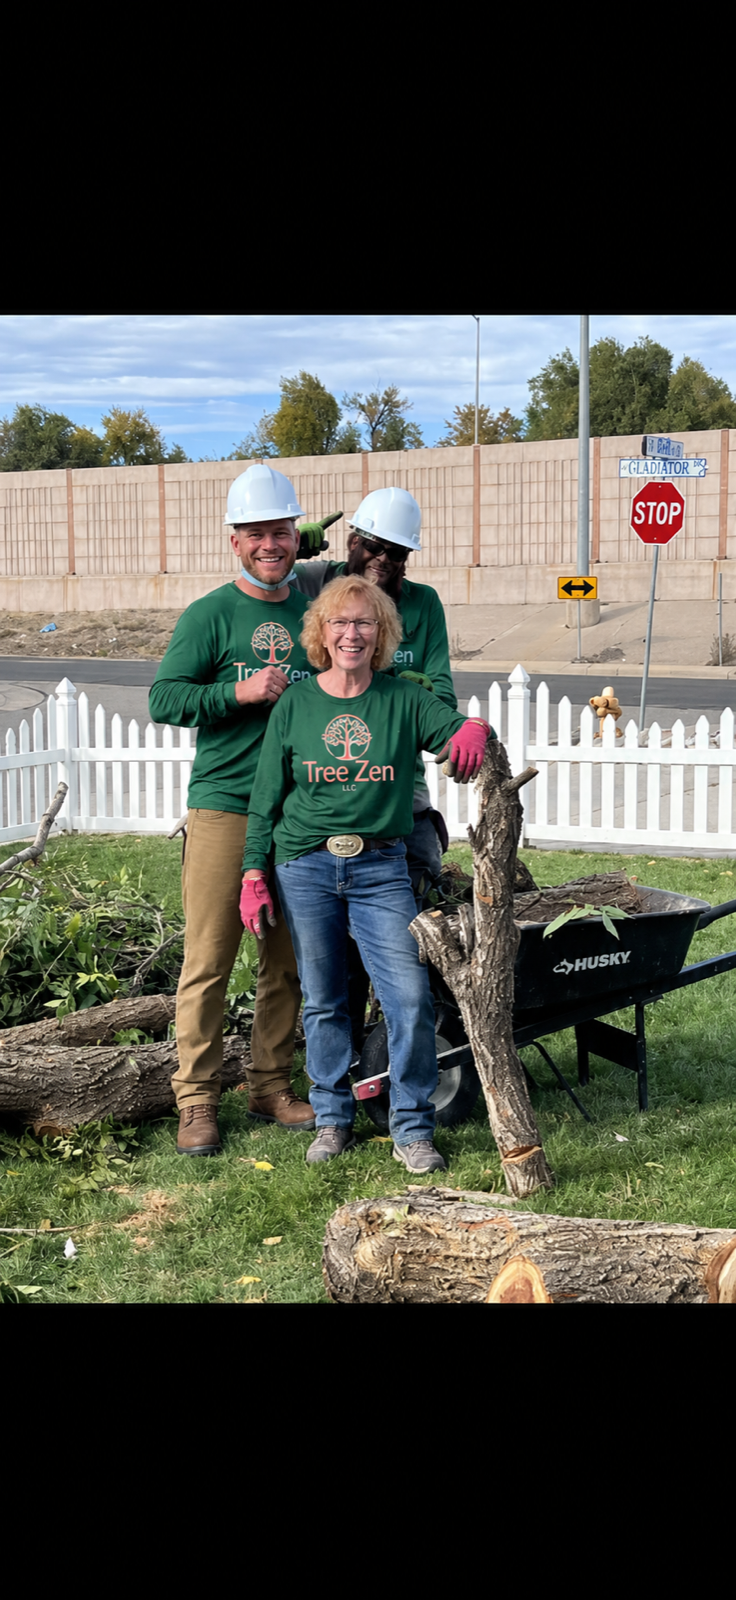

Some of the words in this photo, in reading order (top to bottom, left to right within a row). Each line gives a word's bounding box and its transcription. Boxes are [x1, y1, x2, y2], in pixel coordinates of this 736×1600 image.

[628, 460, 690, 475] GLADIATOR
[633, 501, 682, 525] STOP
[392, 650, 414, 663] en
[302, 760, 349, 783] Tree
[354, 760, 395, 782] Zen
[342, 784, 357, 792] LLC
[574, 950, 632, 972] HUSKY
